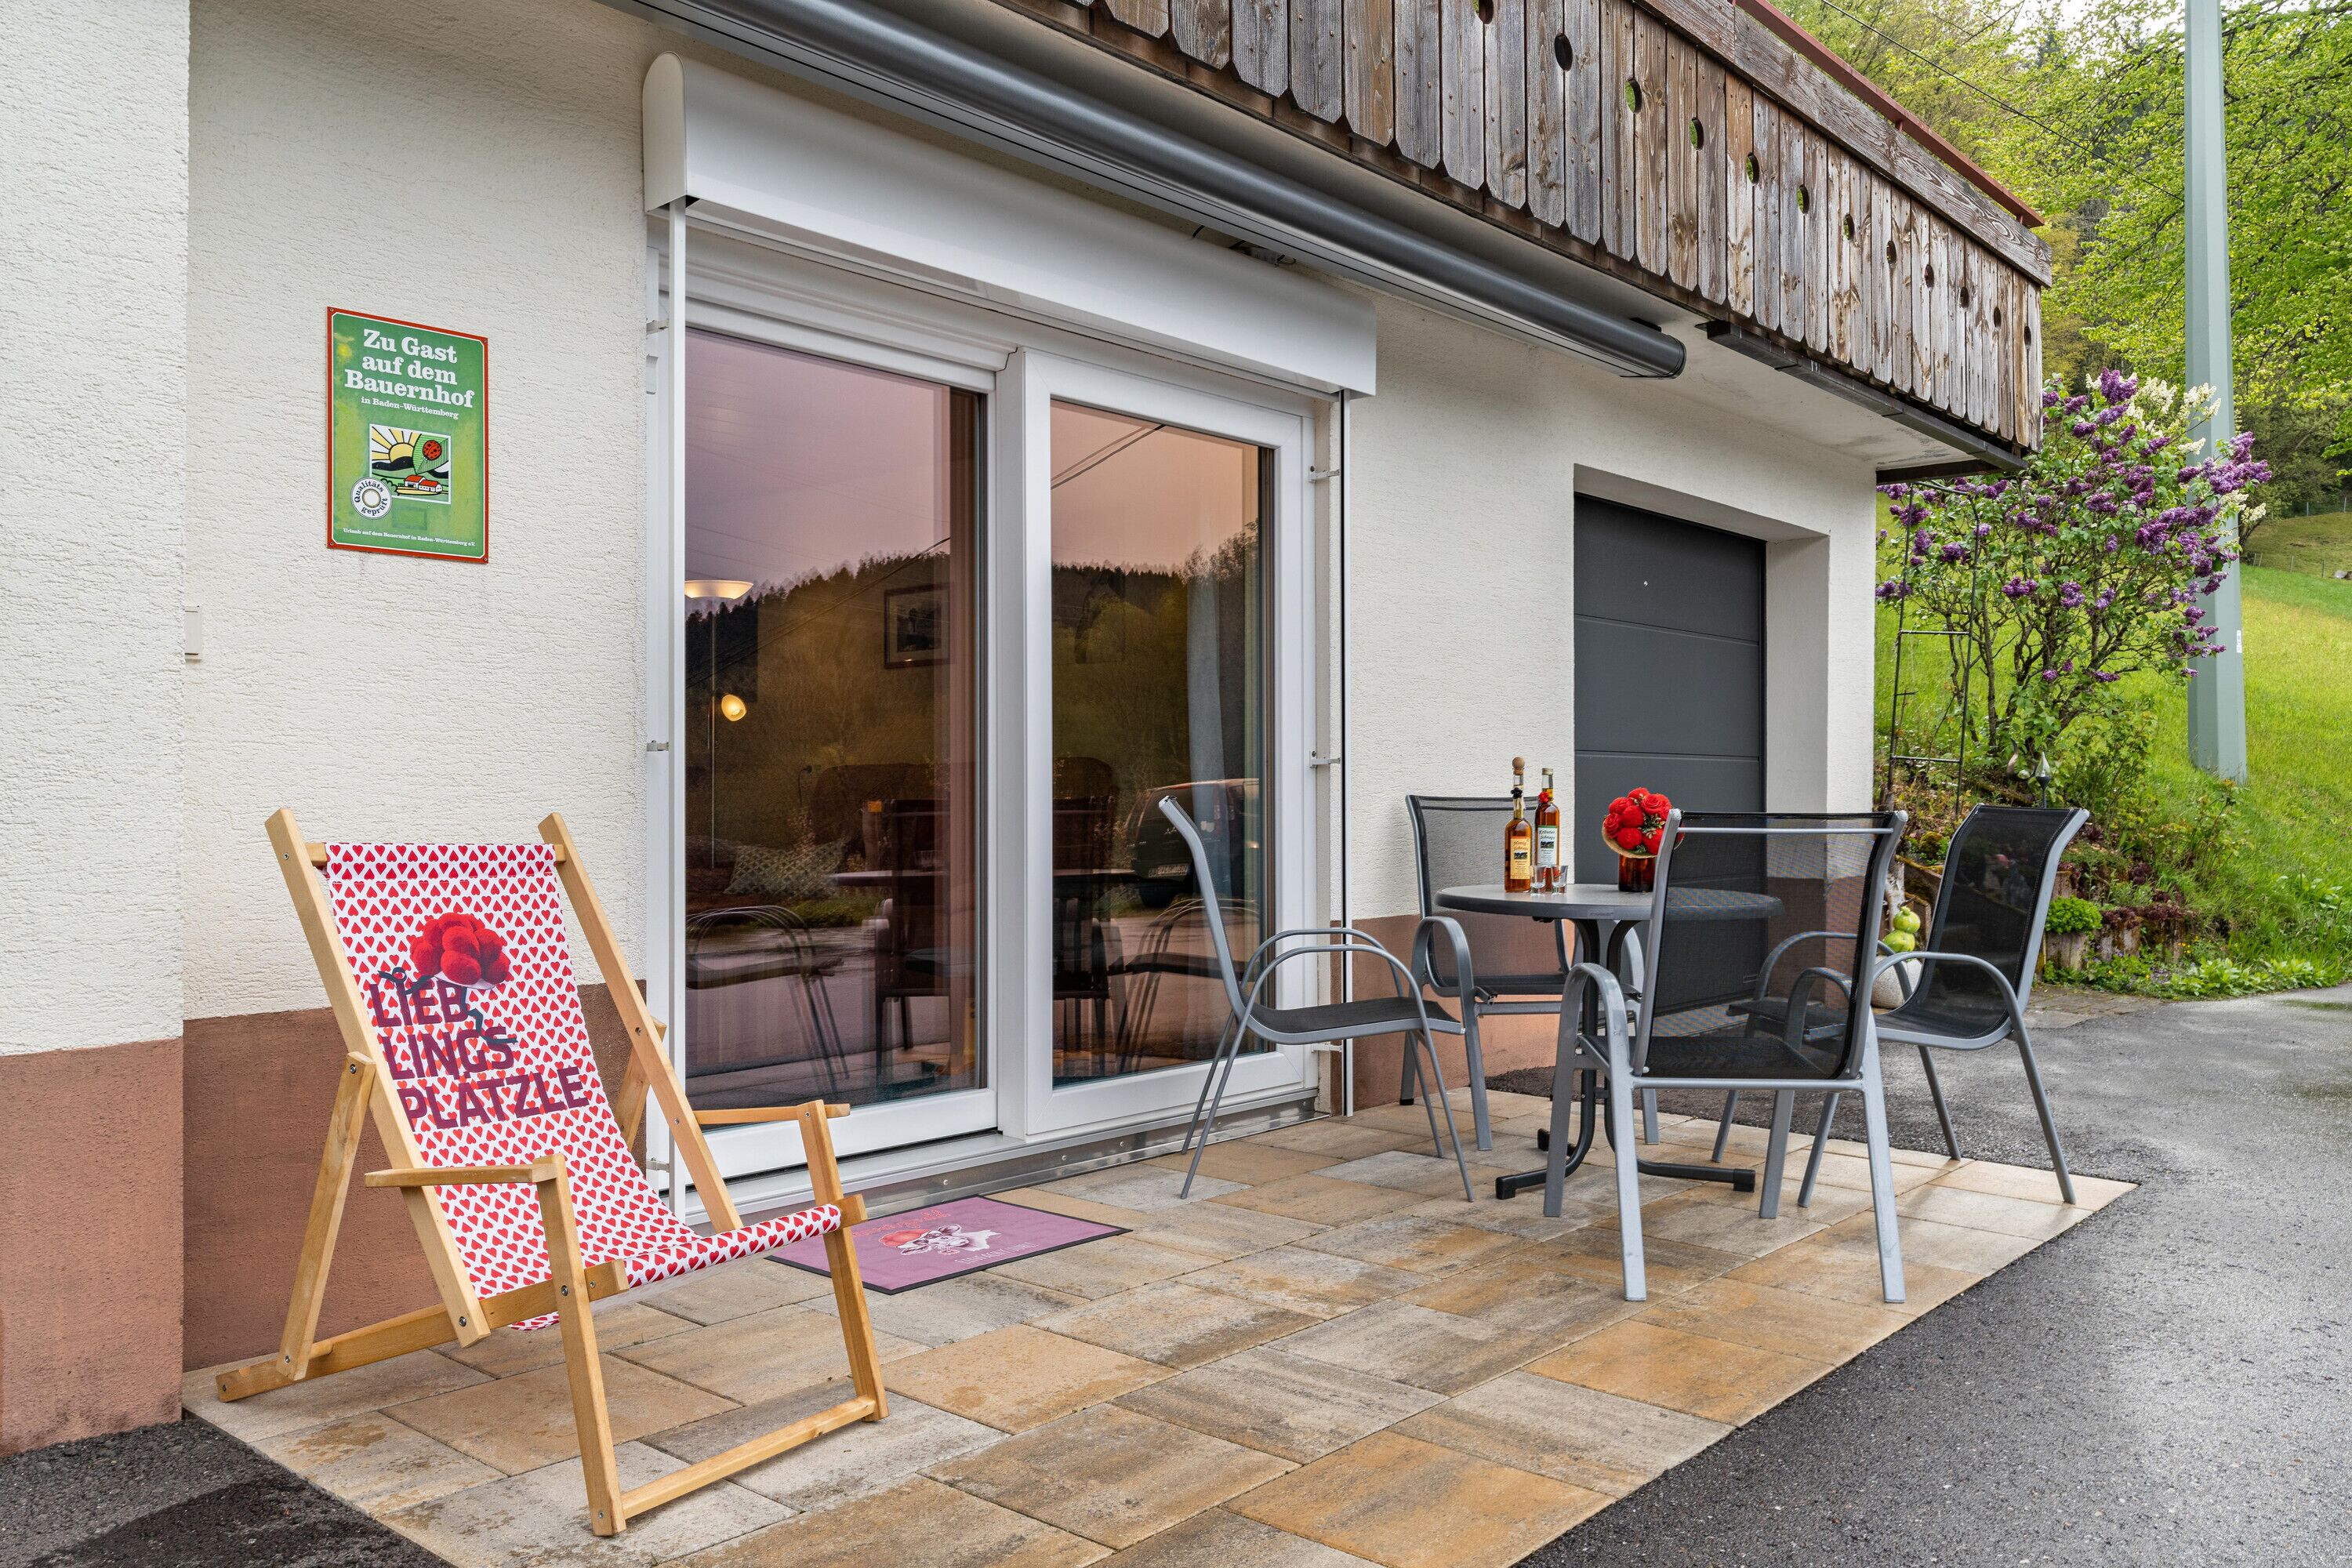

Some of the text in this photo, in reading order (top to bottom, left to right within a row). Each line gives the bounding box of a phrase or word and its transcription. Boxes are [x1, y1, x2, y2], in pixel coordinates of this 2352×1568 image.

[364, 328, 458, 364] Zu Gast
[361, 356, 458, 386] auf dem
[344, 368, 475, 408] Bauernhof
[361, 396, 459, 420] in Baden-Württemberg
[354, 480, 384, 503] Qualitäts
[361, 497, 388, 517] geprüft
[383, 532, 410, 540] Bauernhof
[417, 535, 468, 546] Baden-Württemberg
[369, 979, 469, 1028] LIEB
[380, 1026, 515, 1080] LINGS
